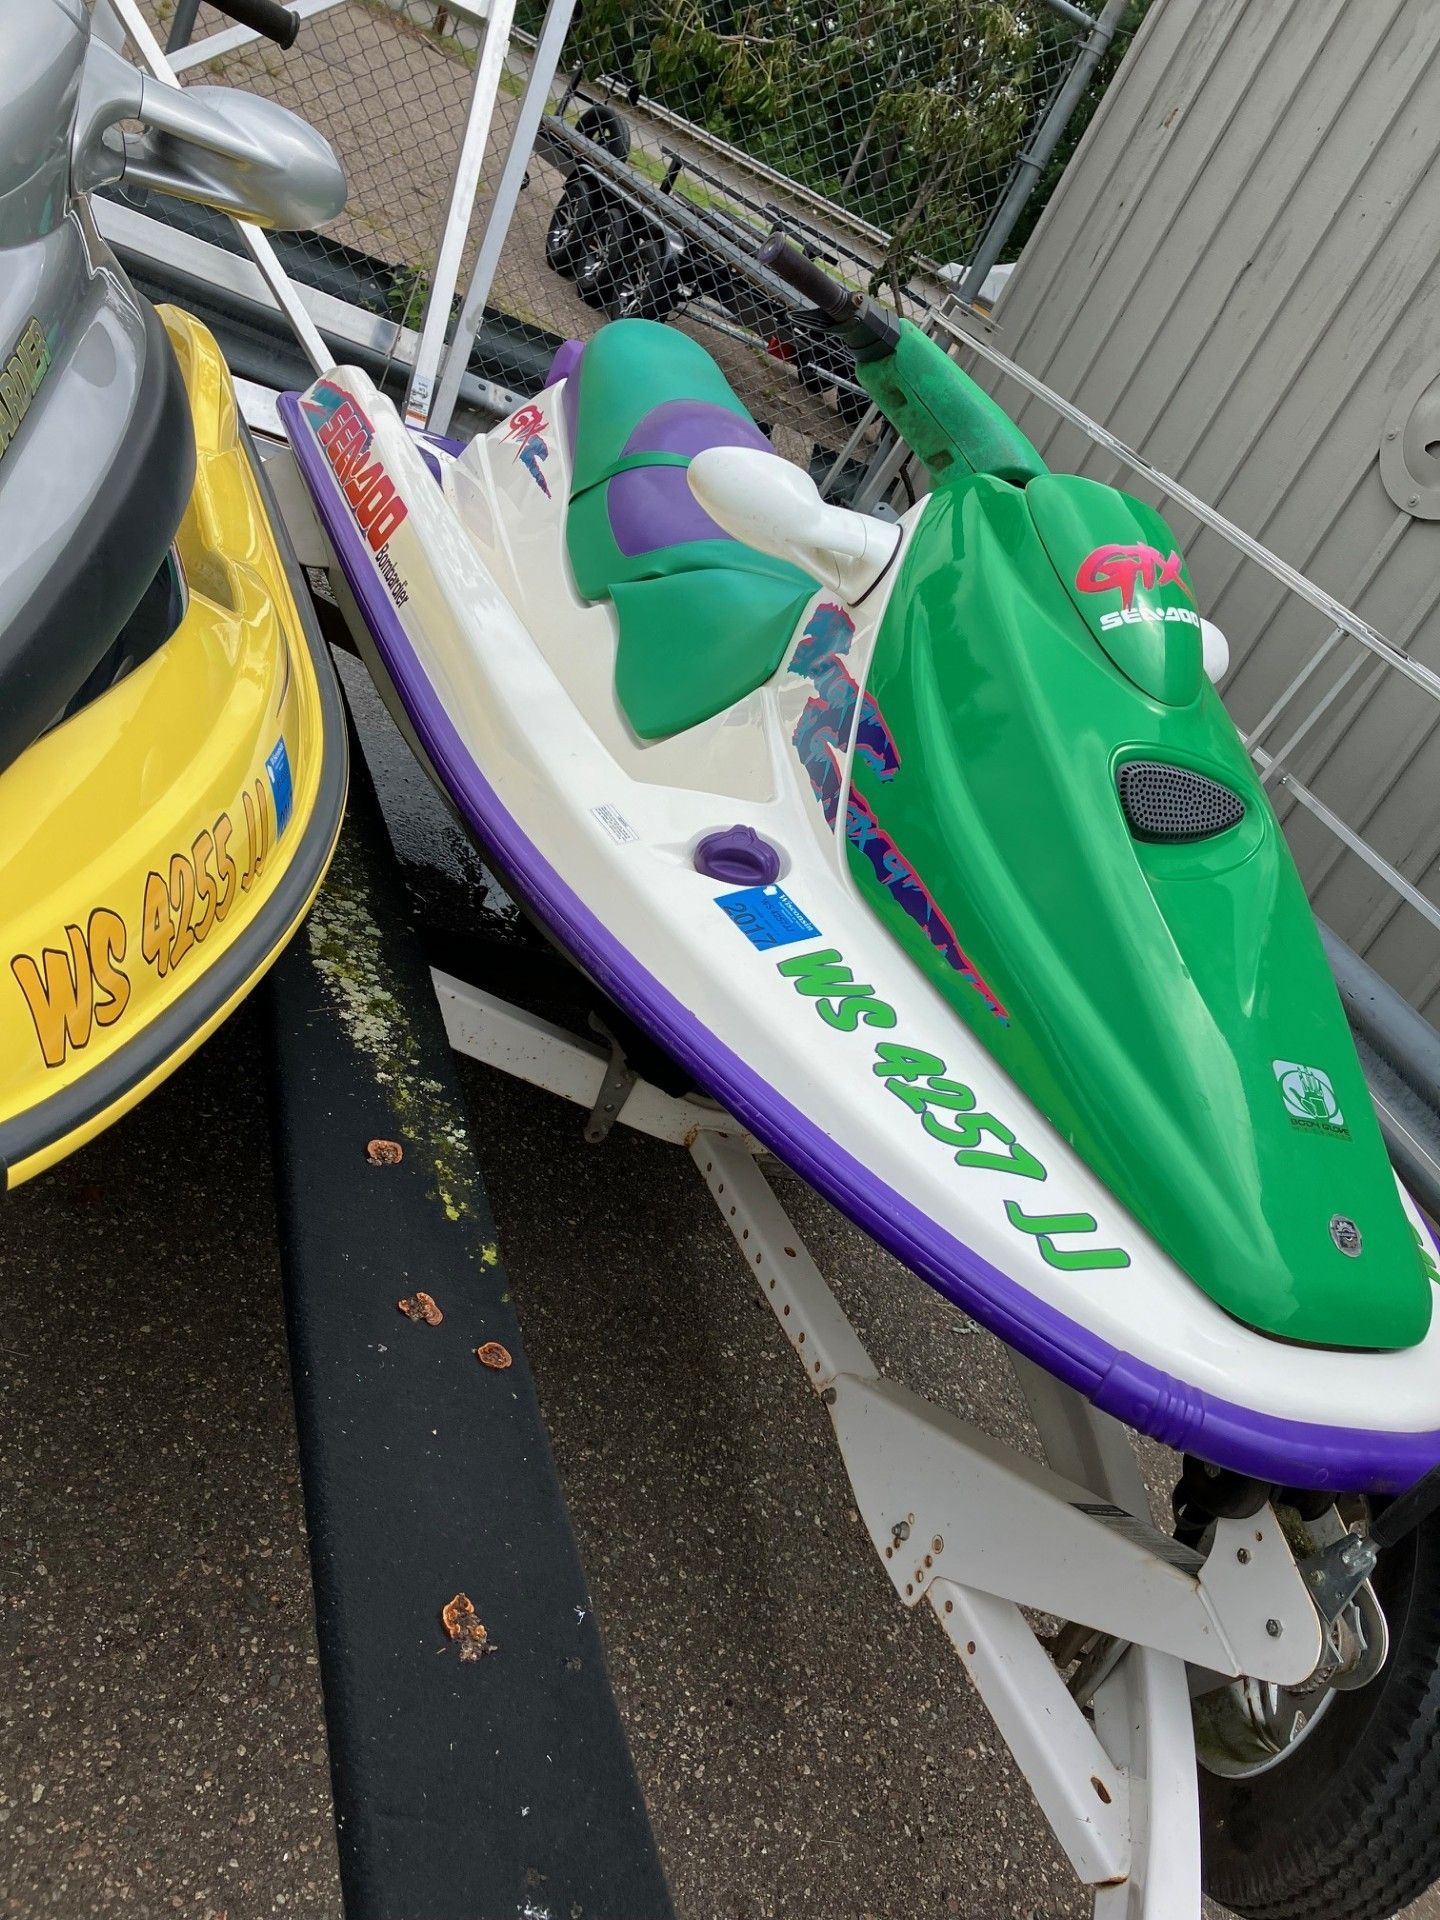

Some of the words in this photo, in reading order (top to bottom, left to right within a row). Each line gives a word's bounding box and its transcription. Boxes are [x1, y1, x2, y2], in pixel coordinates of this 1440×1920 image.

[0, 315, 51, 459] ARDIER
[374, 542, 410, 609] Bombardier
[1075, 541, 1197, 612] GTX
[10, 906, 131, 1069] WS
[141, 812, 236, 978] 4255
[241, 778, 269, 893] JJ
[723, 902, 778, 945] 2017
[778, 893, 815, 932] Wisconsin
[776, 948, 897, 1032] WS
[873, 1042, 1047, 1182] 4257
[1003, 1199, 1131, 1271] JJ
